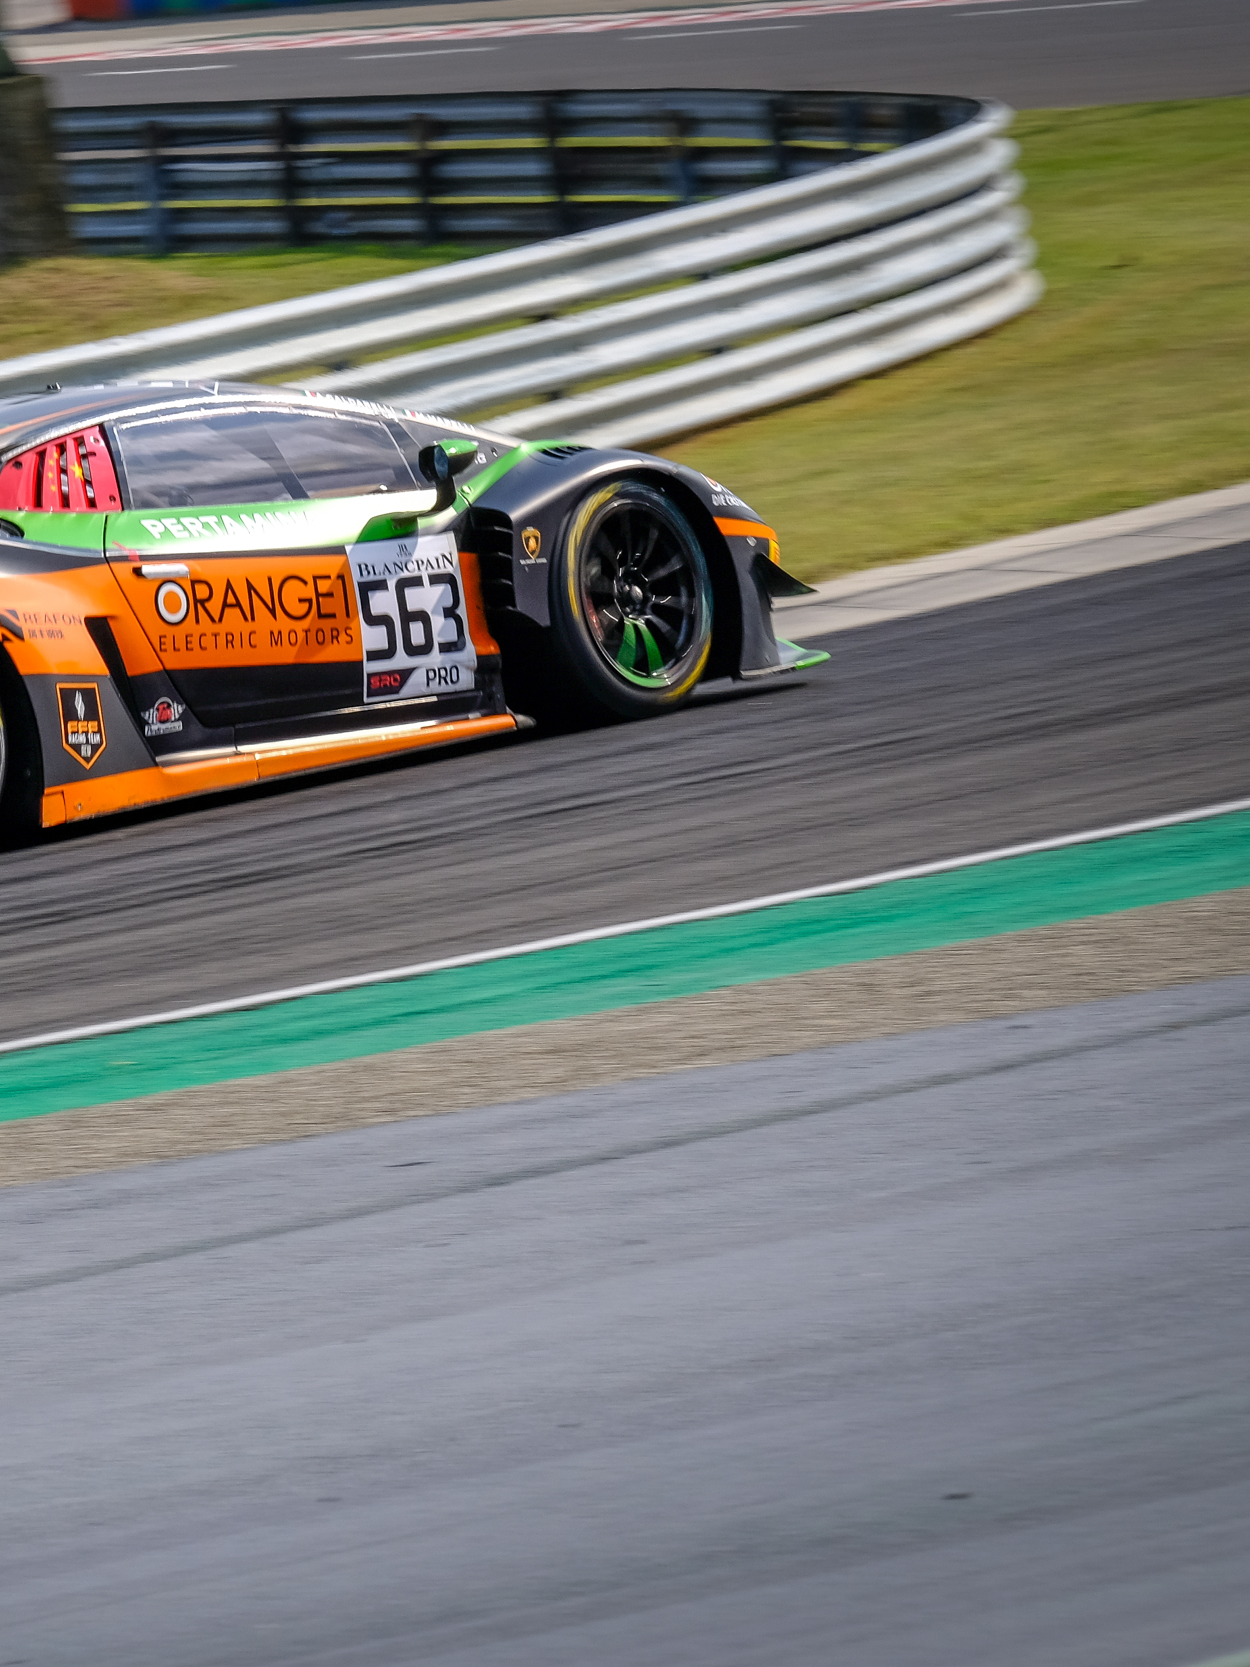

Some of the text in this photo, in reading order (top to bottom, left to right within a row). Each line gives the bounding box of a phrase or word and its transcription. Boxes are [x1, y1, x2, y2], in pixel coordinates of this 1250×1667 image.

[139, 510, 318, 541] PERTAMIN
[357, 552, 455, 578] BLANCPAIN
[155, 574, 350, 625] ORANGE1
[358, 572, 466, 662] 563
[159, 627, 354, 652] ELECTRIC MOTORS
[370, 673, 401, 690] SRO
[425, 665, 460, 688] PRO
